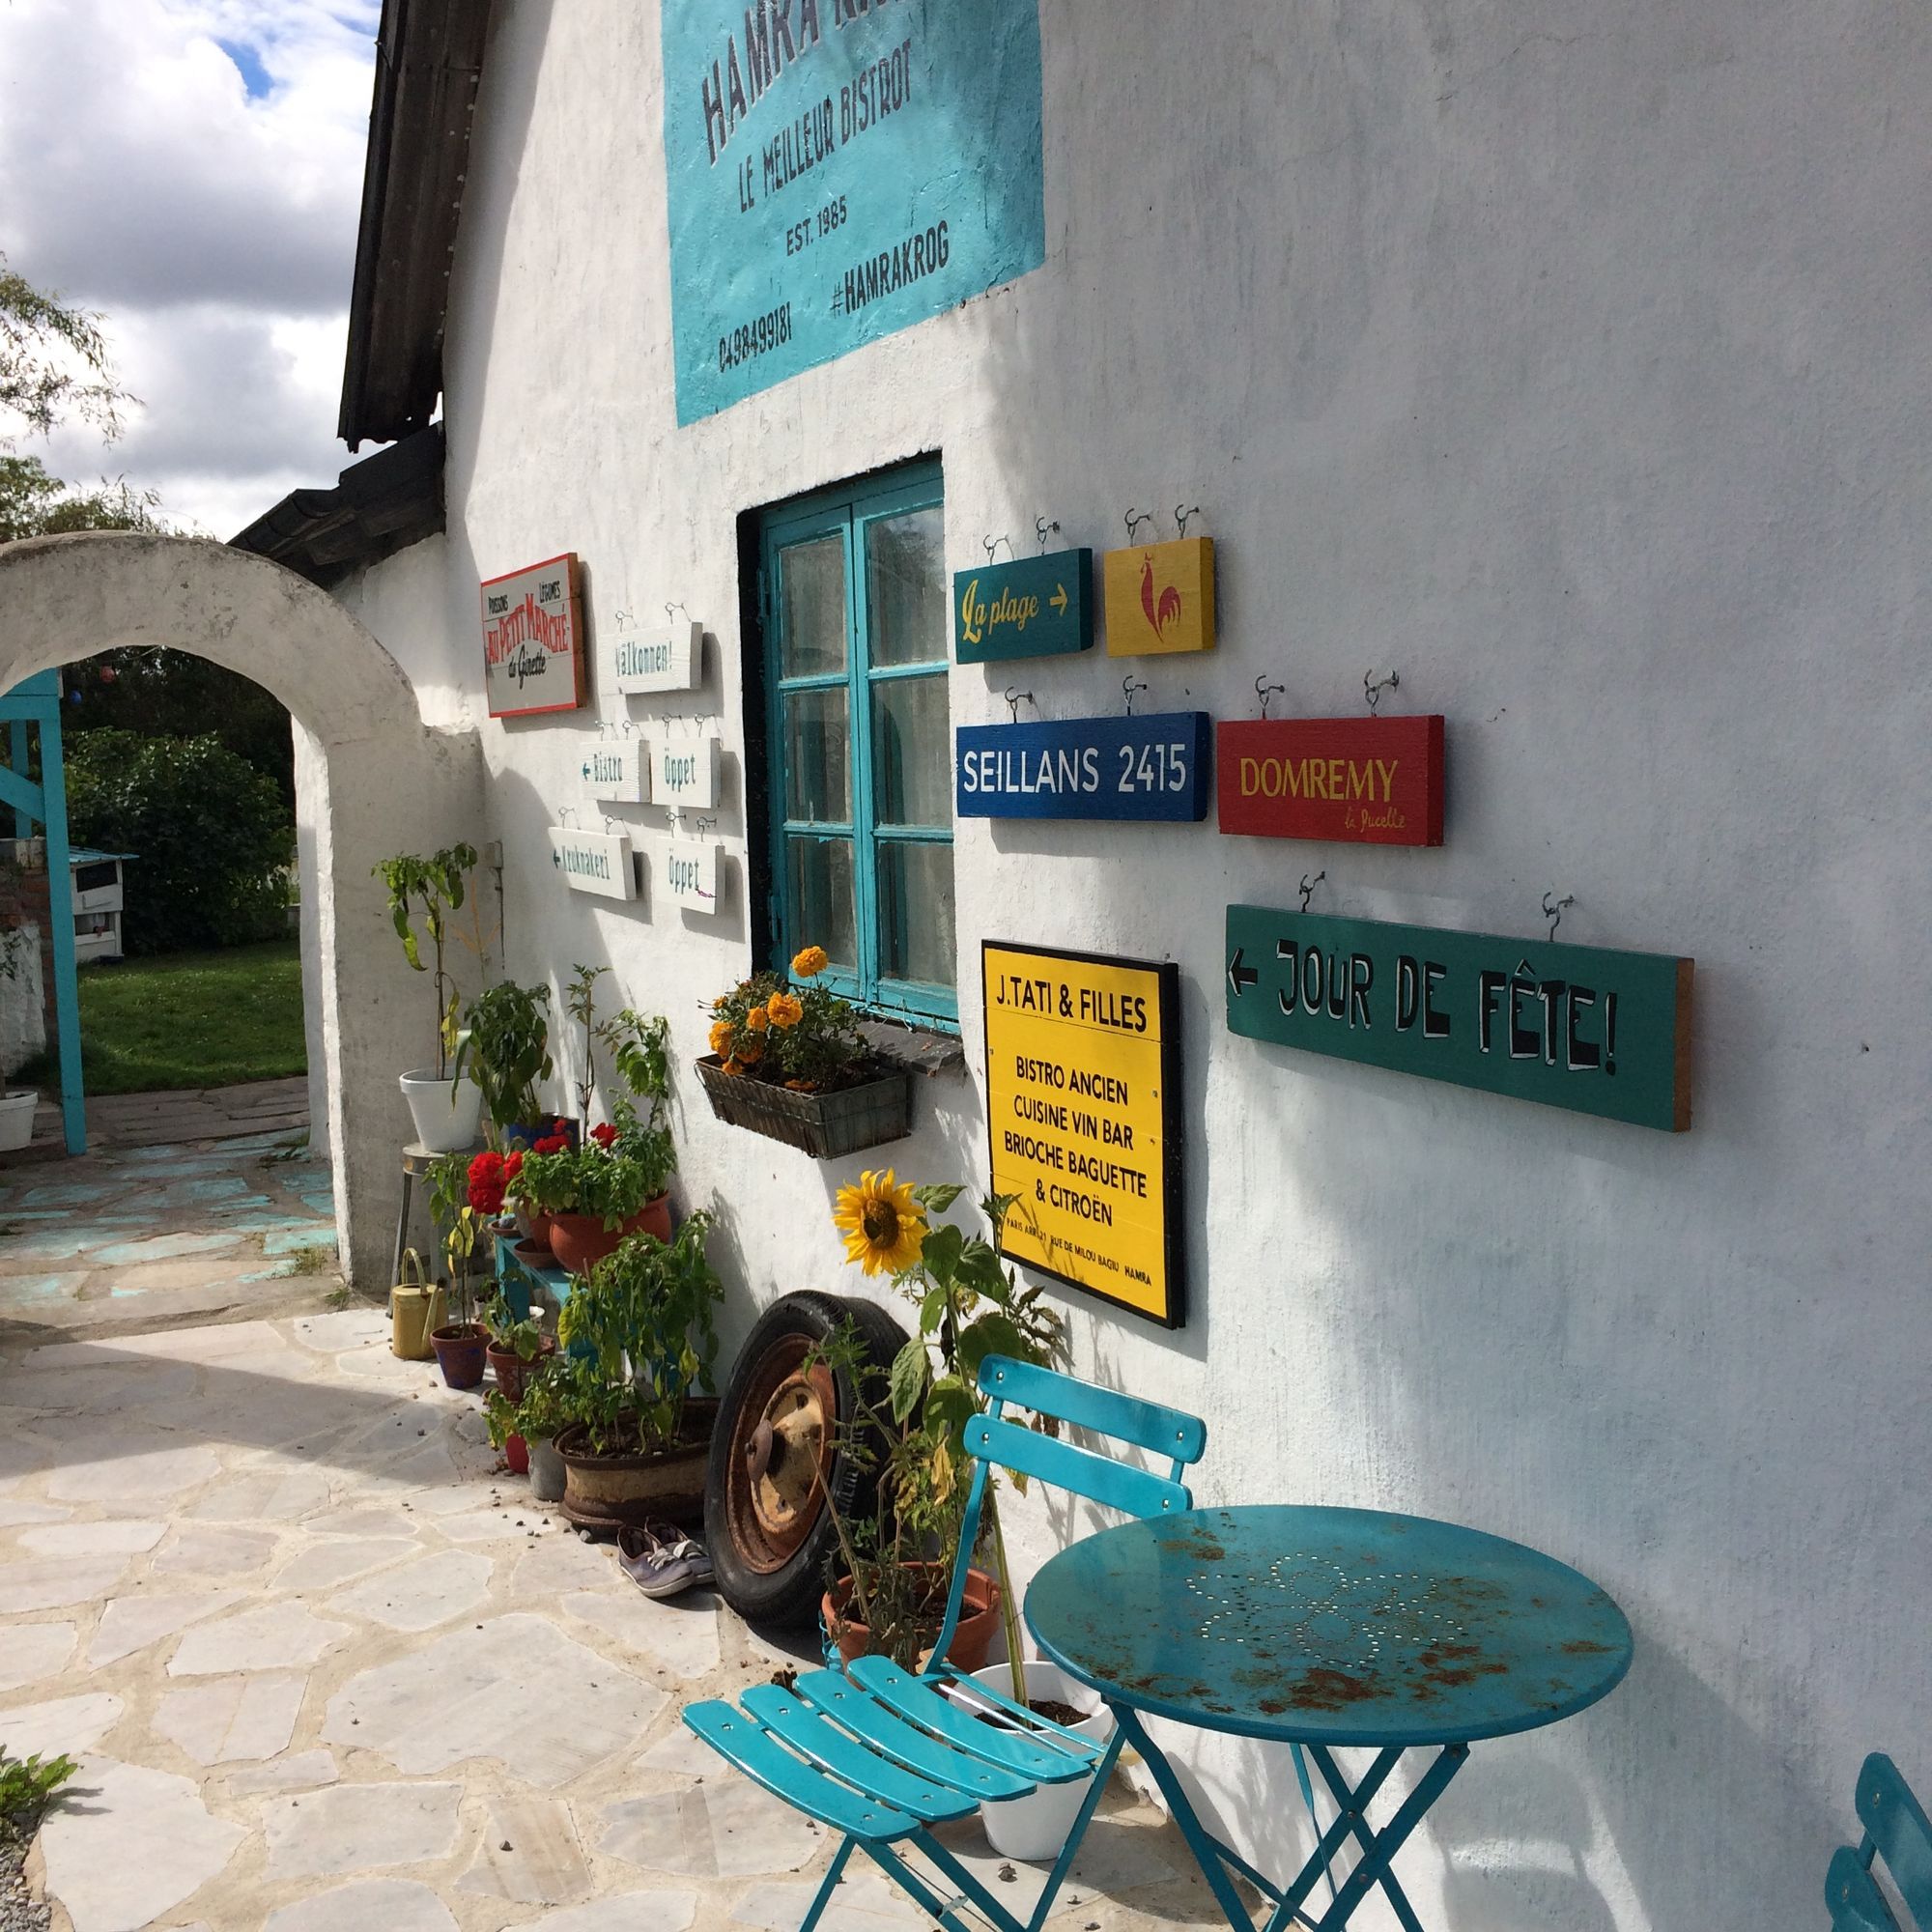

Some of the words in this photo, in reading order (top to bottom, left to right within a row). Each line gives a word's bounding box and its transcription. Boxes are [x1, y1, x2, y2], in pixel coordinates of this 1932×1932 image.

[738, 154, 754, 213] LE
[762, 95, 835, 196] MEILLEUR
[840, 39, 911, 146] BISTROT
[786, 216, 814, 256] EST.
[817, 194, 847, 238] 1985
[829, 220, 950, 318] #HAMRAKROG
[719, 300, 792, 373] 0498499181
[488, 630, 498, 665] AU
[498, 604, 525, 662] PETIT
[526, 593, 569, 653] MARCHÉ
[961, 580, 986, 643] La
[988, 585, 1039, 636] plage
[615, 640, 673, 677] Välkommen!
[593, 752, 623, 781] Bistro
[664, 747, 696, 792] Öppet
[963, 748, 1100, 794] SEILLANS
[1118, 743, 1187, 793] 2415
[1240, 757, 1399, 803] DOMREMY
[668, 848, 701, 895] Öppet
[1059, 983, 1074, 1018] &
[1080, 987, 1148, 1033] FILLES
[1276, 939, 1375, 1031] JOUR
[1395, 955, 1450, 1038] DE
[1479, 959, 1619, 1077] FÊTE!
[1015, 1055, 1064, 1090] BISTRO
[1068, 1071, 1128, 1106] ANCIEN
[1013, 1094, 1067, 1131] CUISINE
[1071, 1114, 1098, 1141] VIN
[1101, 1121, 1134, 1151] BAR
[1004, 1130, 1064, 1171] BRIOCHE
[1068, 1151, 1148, 1199] BAGUETTE
[1035, 1178, 1046, 1204] &
[1049, 1185, 1113, 1227] CITROËN
[1049, 1236, 1064, 1249] RUE
[1064, 1239, 1073, 1253] DE
[1074, 1244, 1096, 1263] MILOU
[1124, 1265, 1152, 1287] HAMRA
